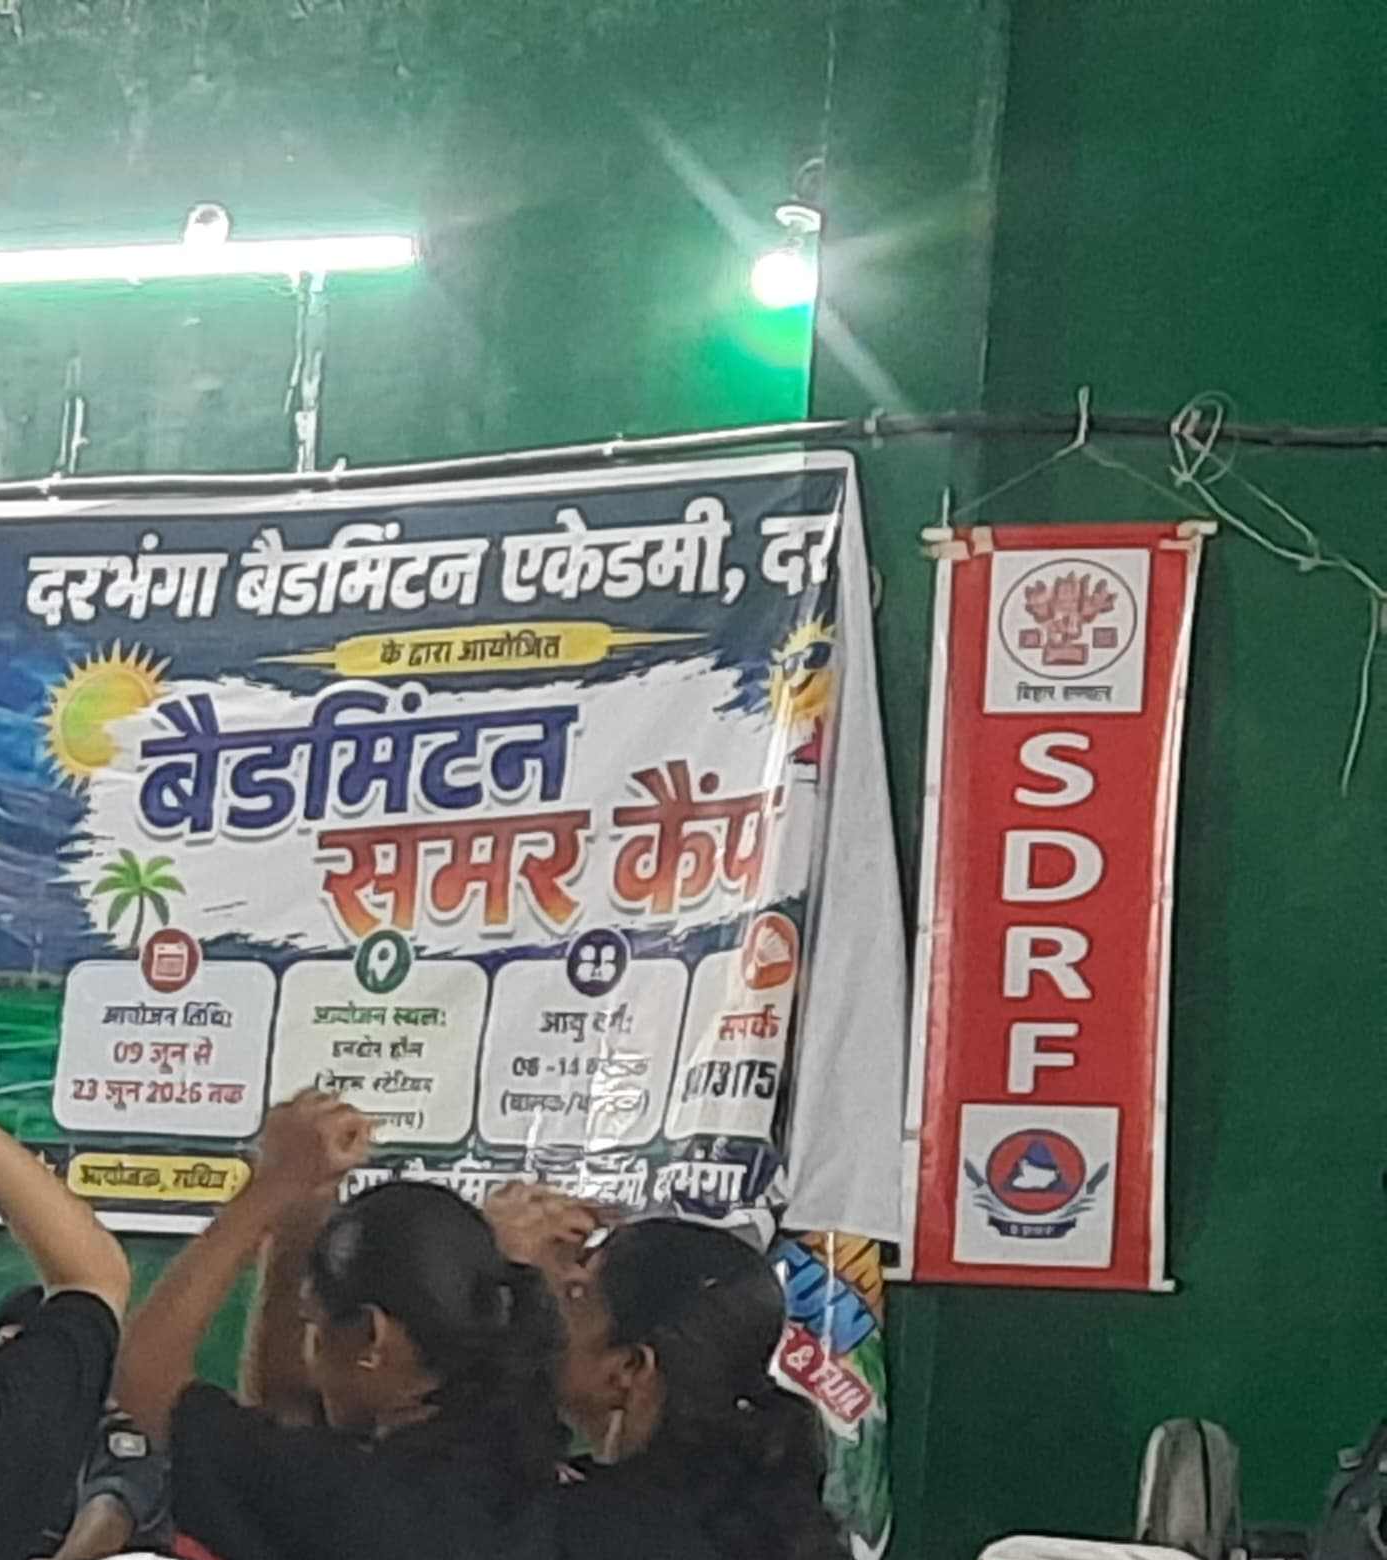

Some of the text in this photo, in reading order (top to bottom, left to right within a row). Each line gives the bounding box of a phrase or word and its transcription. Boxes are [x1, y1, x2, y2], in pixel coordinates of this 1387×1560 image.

[27, 533, 228, 626] दरभंगा
[236, 522, 489, 615] बैडमिंटन
[501, 496, 745, 604] एकेडमी,
[380, 629, 562, 667] के द्वारा आयोजित
[141, 690, 578, 832] बैडमिंटन
[318, 808, 592, 938] समर
[1001, 731, 1105, 1094] SDRF
[105, 1079, 144, 1110] जून
[113, 1036, 214, 1074] 09 जून से
